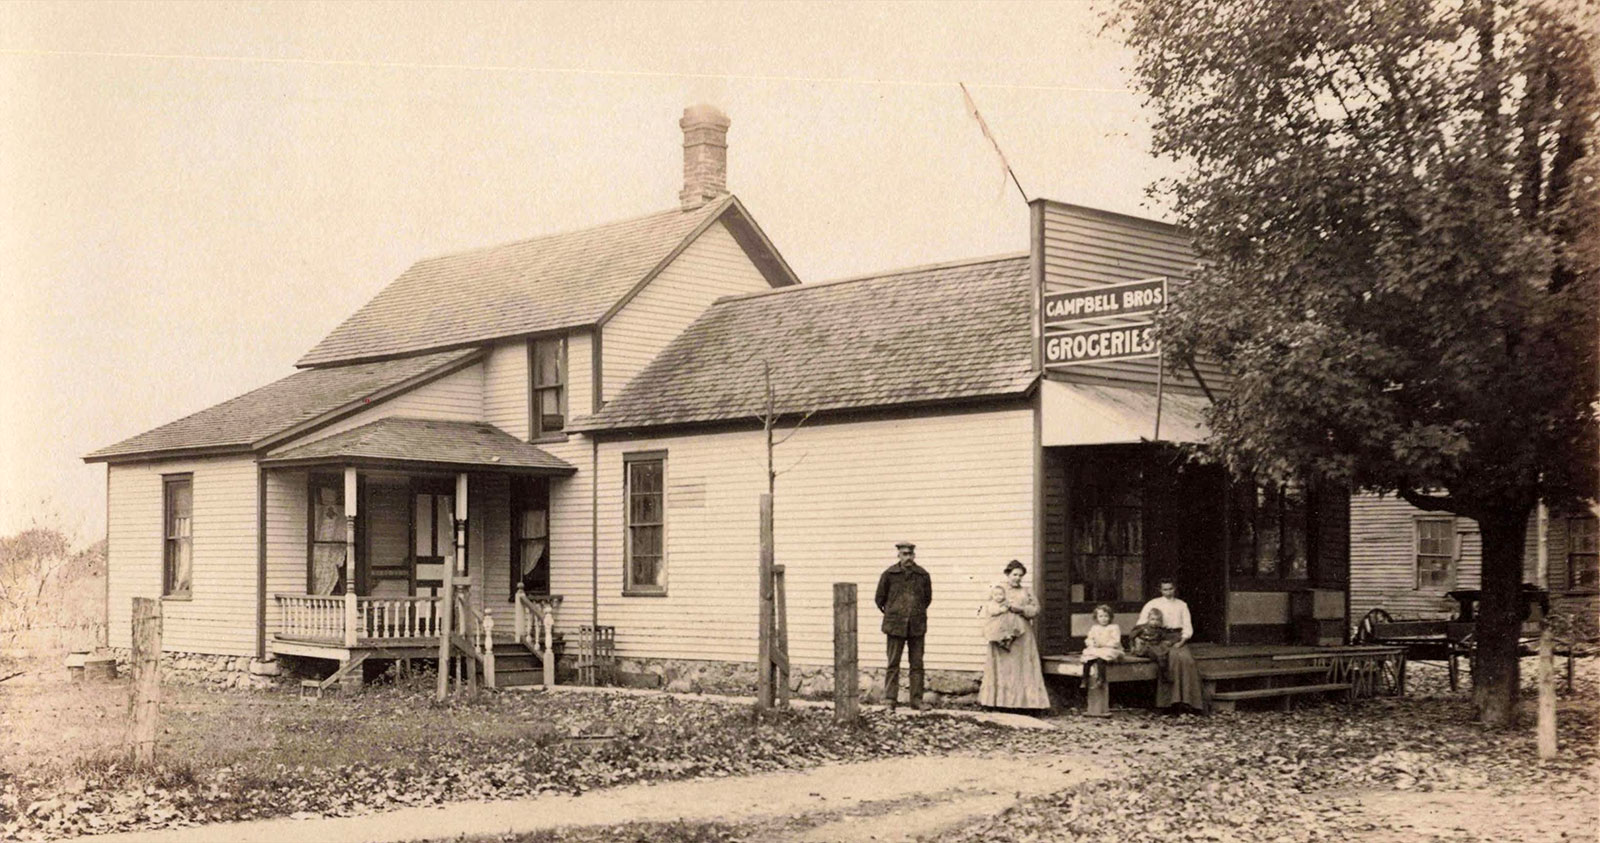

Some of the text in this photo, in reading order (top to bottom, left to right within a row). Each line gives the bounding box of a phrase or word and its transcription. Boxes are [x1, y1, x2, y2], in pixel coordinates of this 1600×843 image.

[1046, 287, 1162, 317] CAMPBELL BROS
[1046, 327, 1155, 361] GROCERIES
